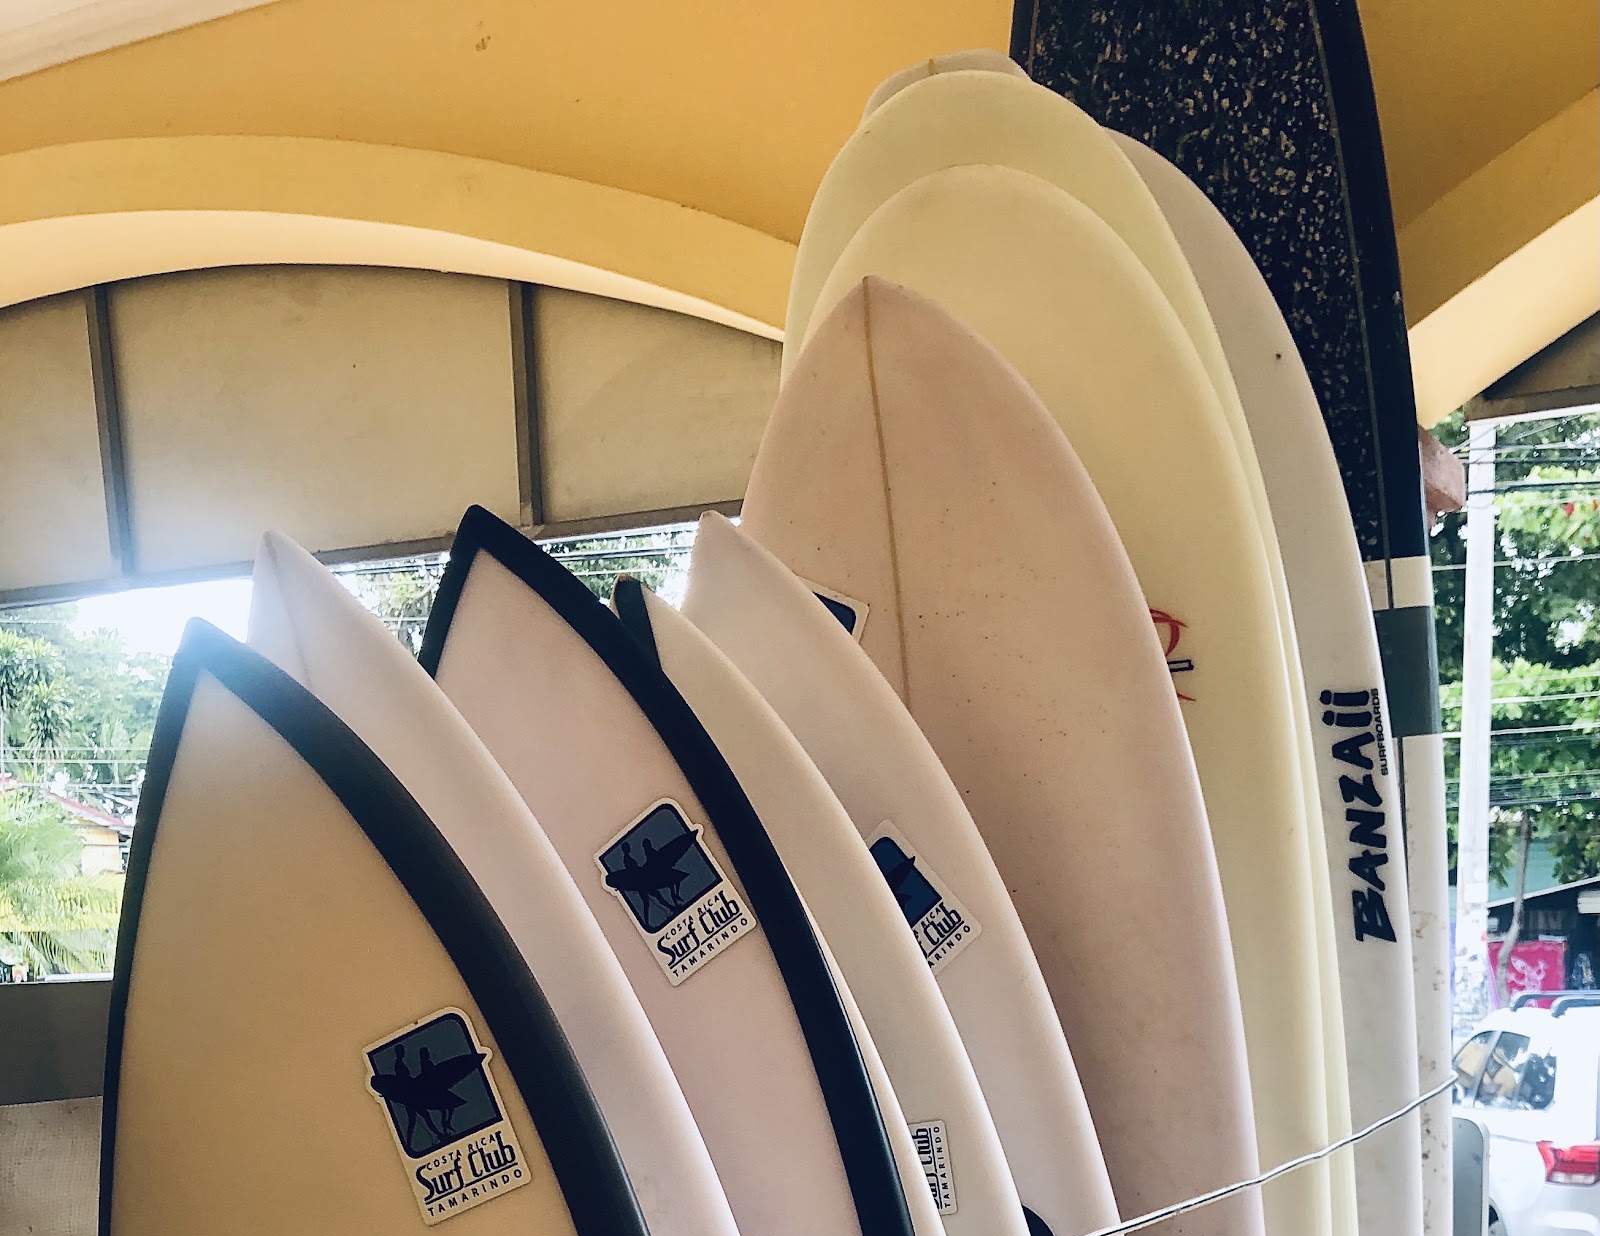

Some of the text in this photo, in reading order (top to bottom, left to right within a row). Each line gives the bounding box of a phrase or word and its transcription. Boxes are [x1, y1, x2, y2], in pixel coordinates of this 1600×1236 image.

[1370, 688, 1389, 776] SURFBOARDS
[657, 890, 740, 967] Surf Club
[665, 896, 720, 940] COSTA RICA
[920, 907, 941, 928] RICA
[923, 901, 962, 946] Club
[672, 917, 748, 978] TAMARINDO
[927, 925, 971, 969] ARINDO
[415, 1130, 516, 1202] Surf Club
[427, 1135, 496, 1171] COSTA RICA
[933, 1126, 952, 1209] TAMARINDO
[428, 1169, 523, 1217] TAMARINDO
